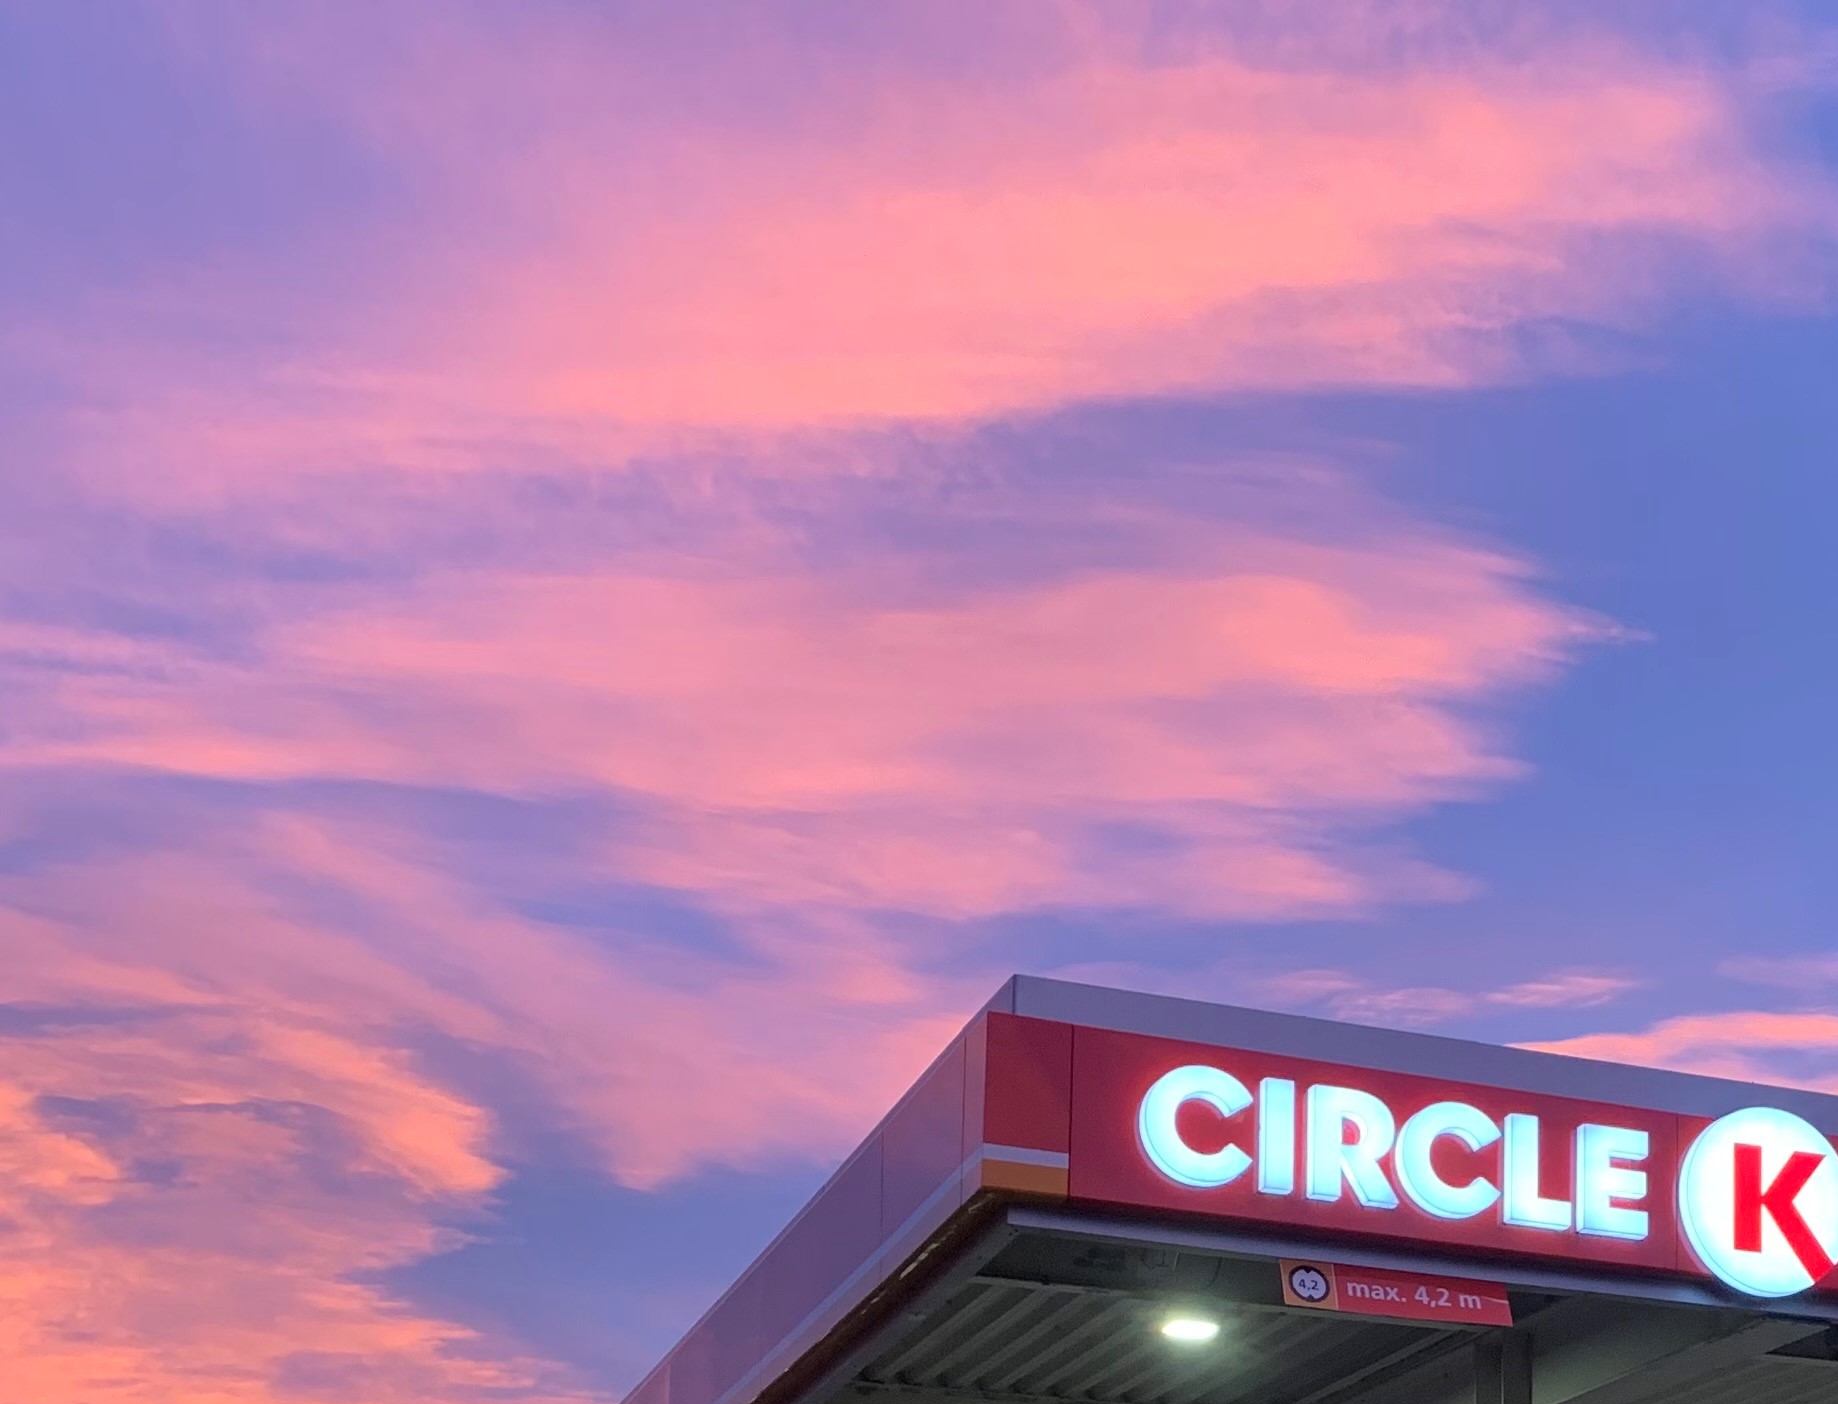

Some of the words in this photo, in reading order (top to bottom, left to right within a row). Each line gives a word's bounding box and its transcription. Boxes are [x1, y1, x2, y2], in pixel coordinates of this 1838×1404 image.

[1138, 1064, 1650, 1241] CIRCLE
[1733, 1142, 1837, 1284] K
[1298, 1279, 1319, 1292] 4,2
[1346, 1280, 1406, 1303] max.
[1414, 1285, 1452, 1309] 4,2
[1459, 1293, 1483, 1310] m
